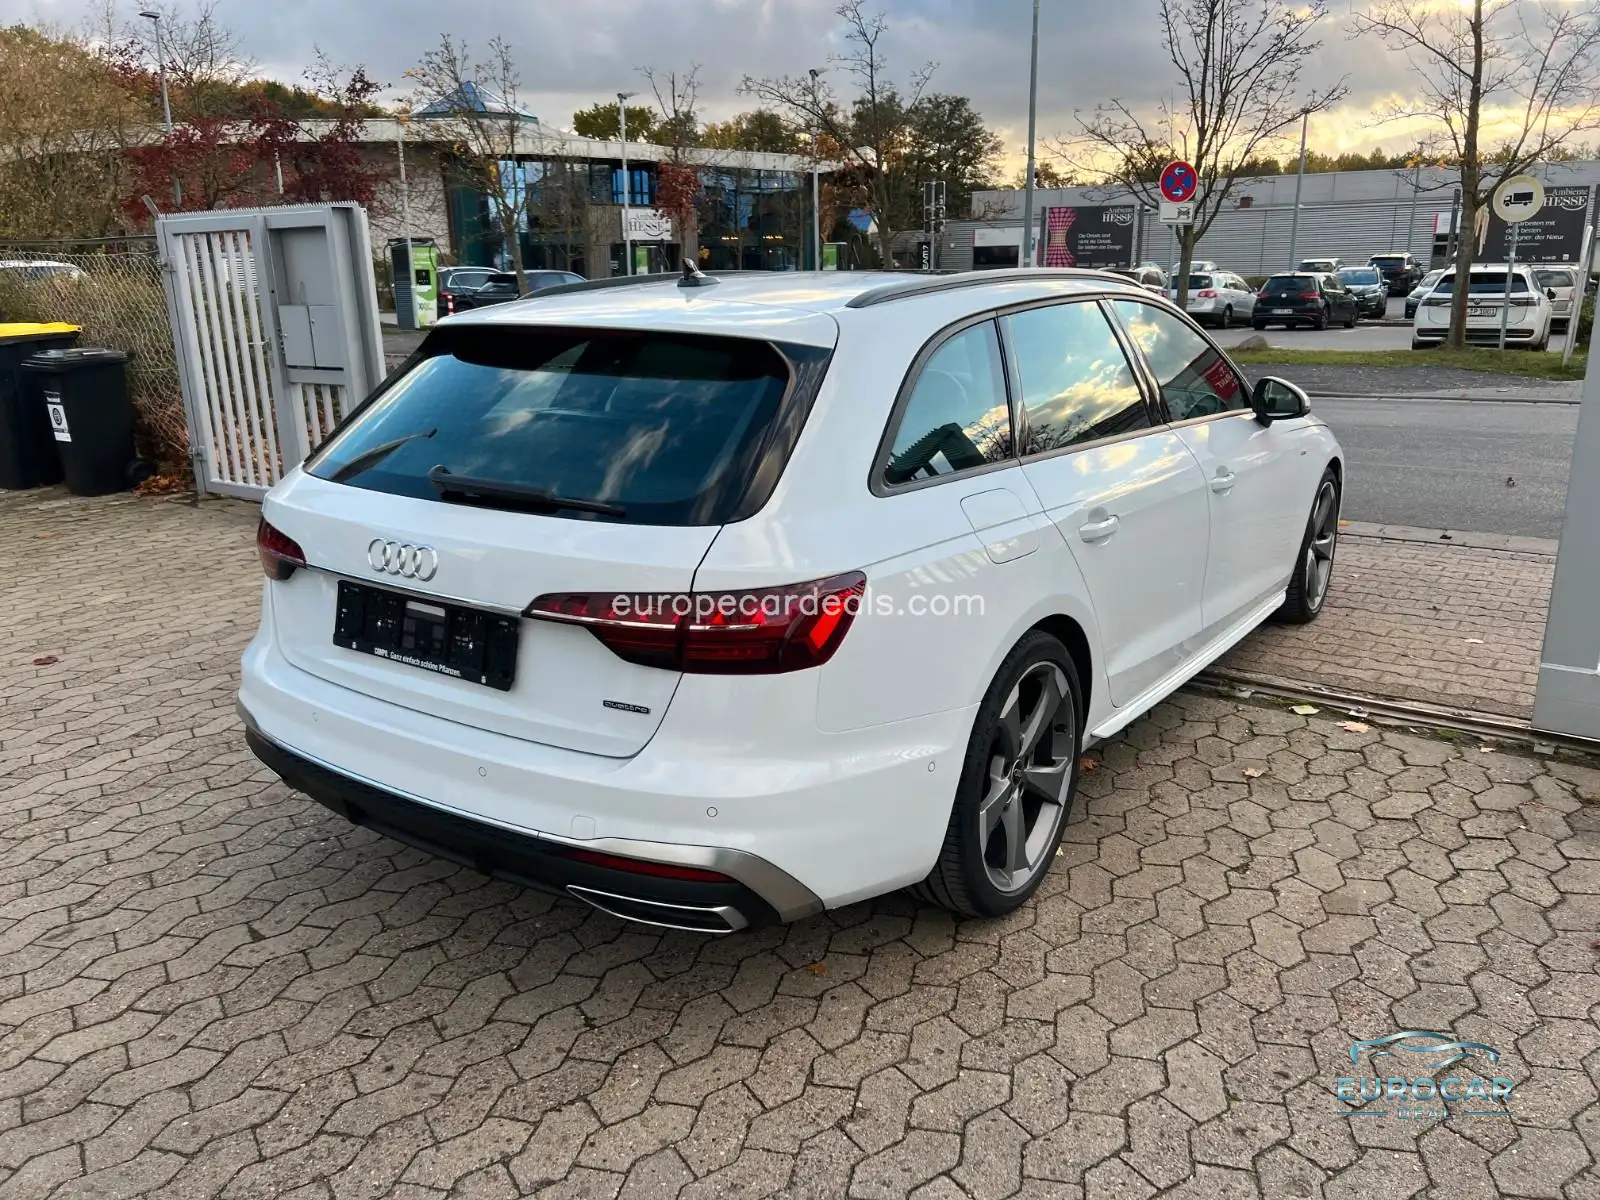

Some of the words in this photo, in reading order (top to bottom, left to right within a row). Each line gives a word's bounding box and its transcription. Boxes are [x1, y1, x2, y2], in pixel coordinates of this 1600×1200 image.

[1543, 195, 1588, 207] HESSE
[1102, 213, 1133, 223] HESSE
[629, 221, 665, 232] HESSE
[390, 651, 402, 661] Ganz
[402, 655, 420, 666] einfach
[420, 660, 438, 671] schöne
[604, 701, 648, 713] quattro
